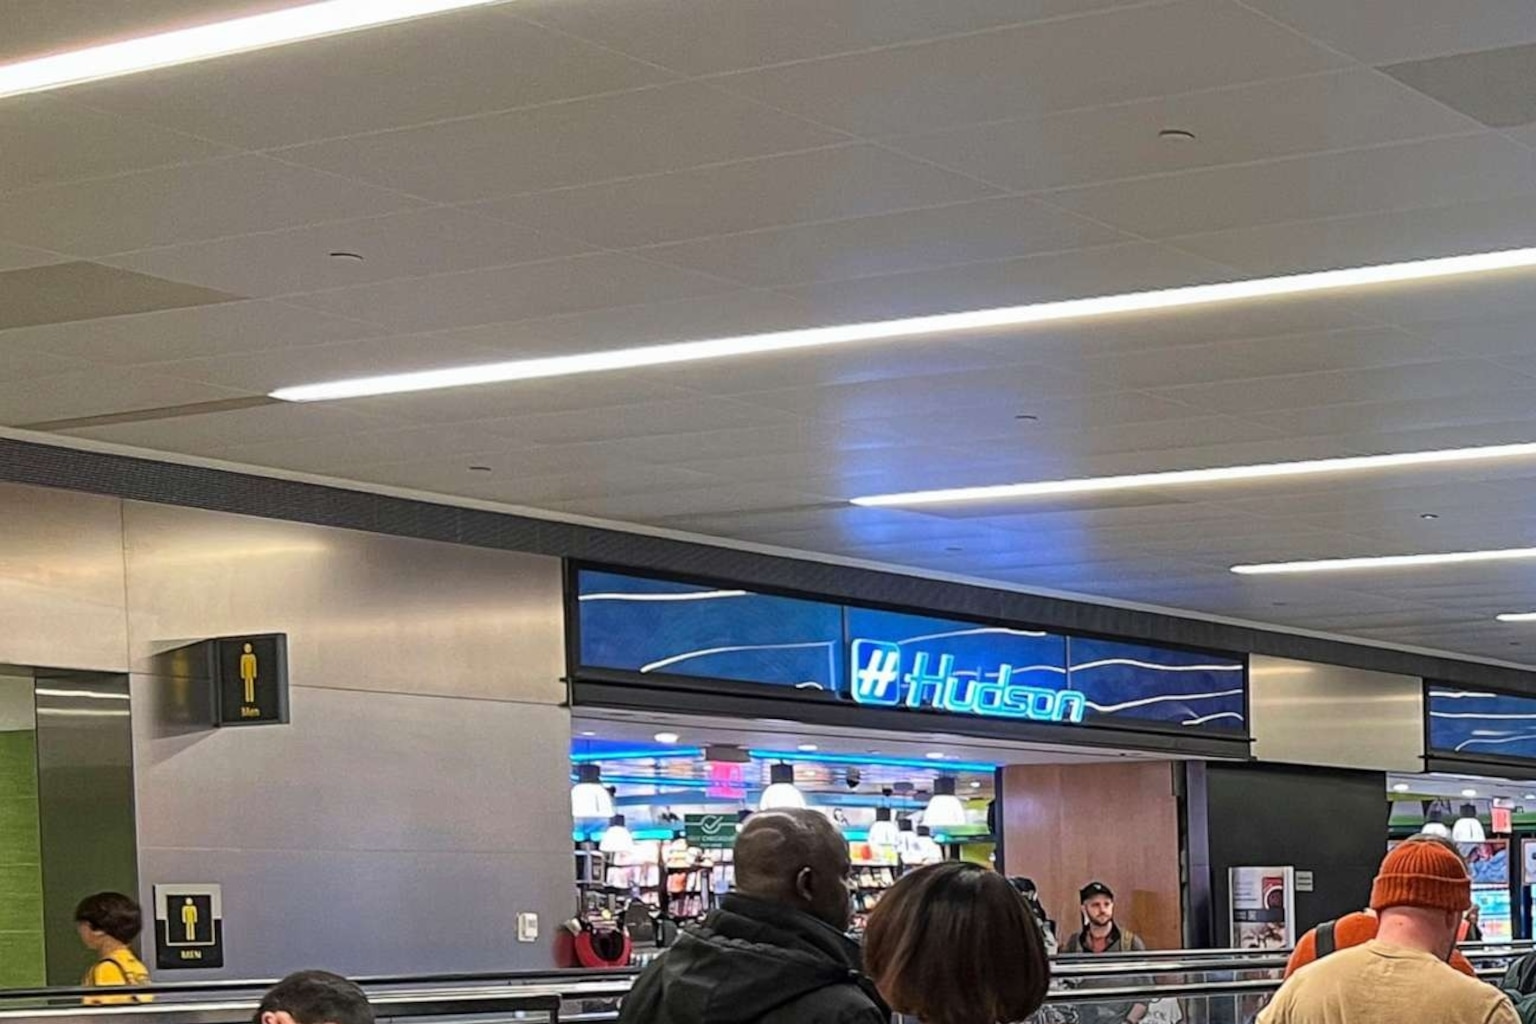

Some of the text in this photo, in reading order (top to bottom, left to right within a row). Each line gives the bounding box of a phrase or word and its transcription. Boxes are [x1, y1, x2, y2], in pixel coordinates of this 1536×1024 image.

[904, 651, 1086, 723] Hudson
[241, 706, 260, 717] Men
[181, 950, 202, 959] MEN
